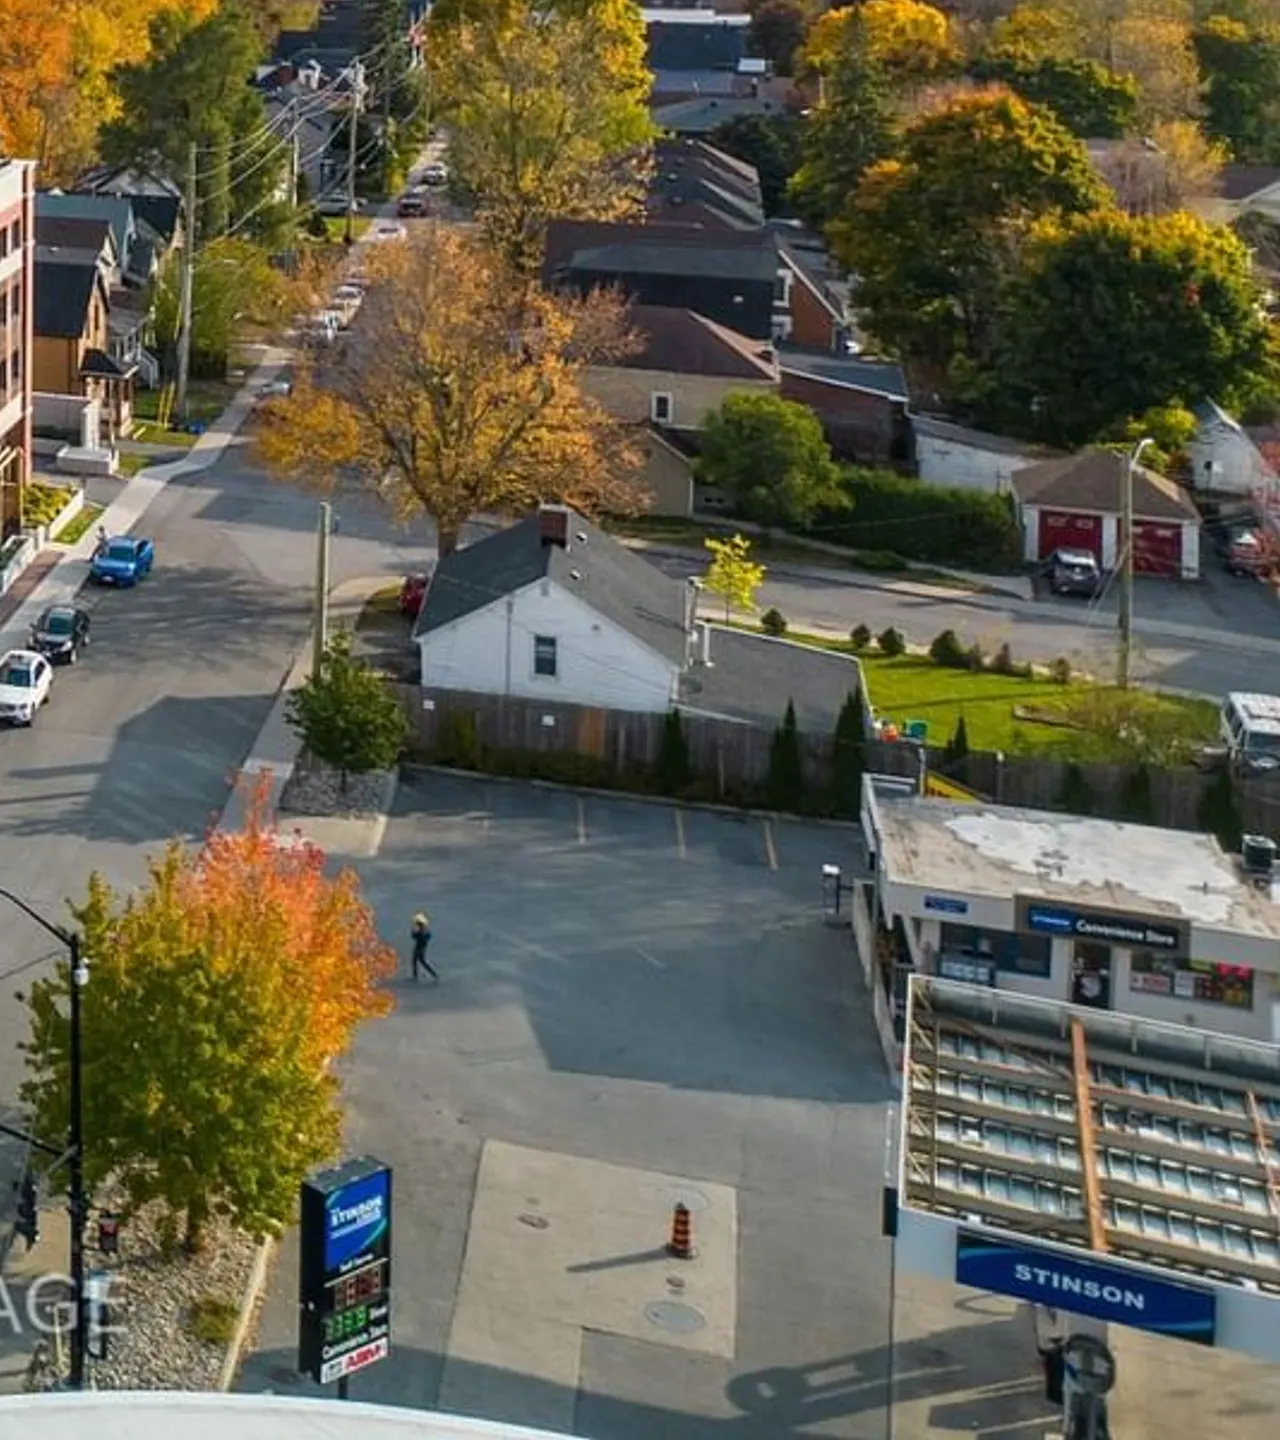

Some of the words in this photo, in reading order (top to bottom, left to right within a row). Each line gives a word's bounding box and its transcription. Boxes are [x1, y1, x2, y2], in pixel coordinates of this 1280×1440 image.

[1075, 918, 1144, 942] Convenience
[1145, 929, 1176, 946] Store
[1014, 1263, 1145, 1311] STINSON
